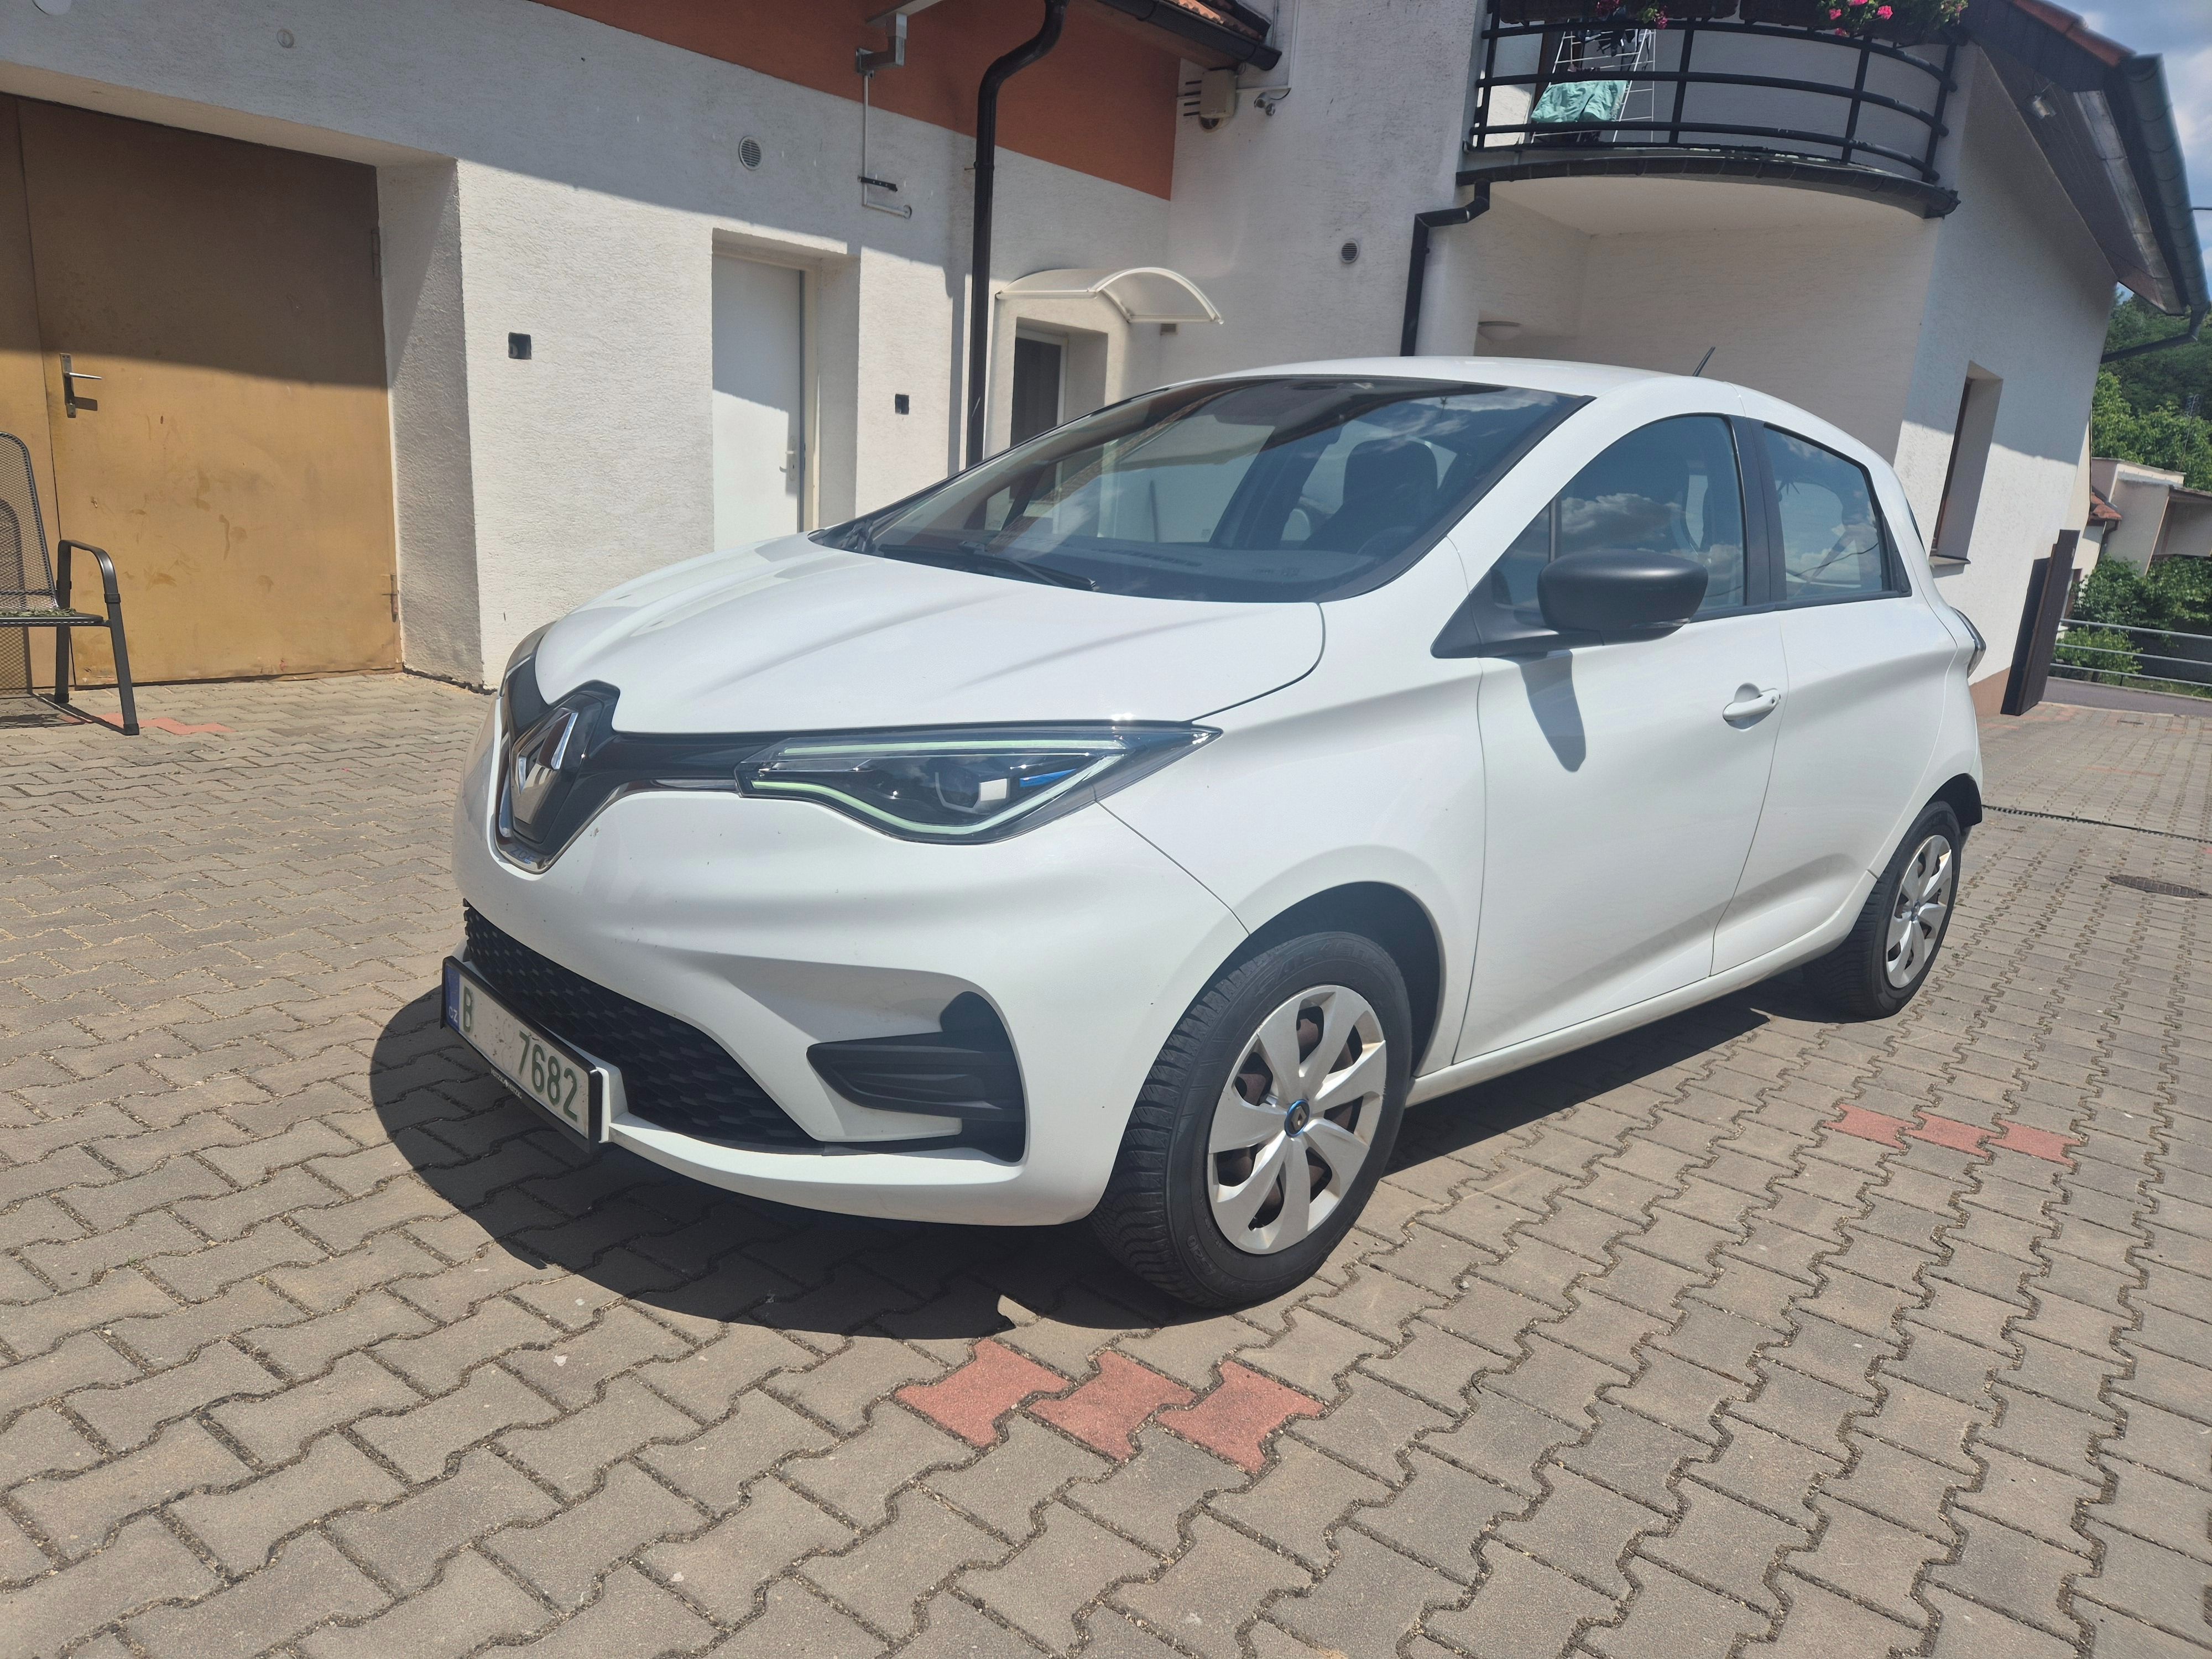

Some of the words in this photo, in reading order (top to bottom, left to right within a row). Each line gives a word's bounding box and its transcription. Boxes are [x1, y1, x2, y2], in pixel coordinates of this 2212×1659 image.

[448, 1006, 458, 1023] CZ
[463, 986, 472, 1033] B
[518, 1030, 578, 1123] 7682
